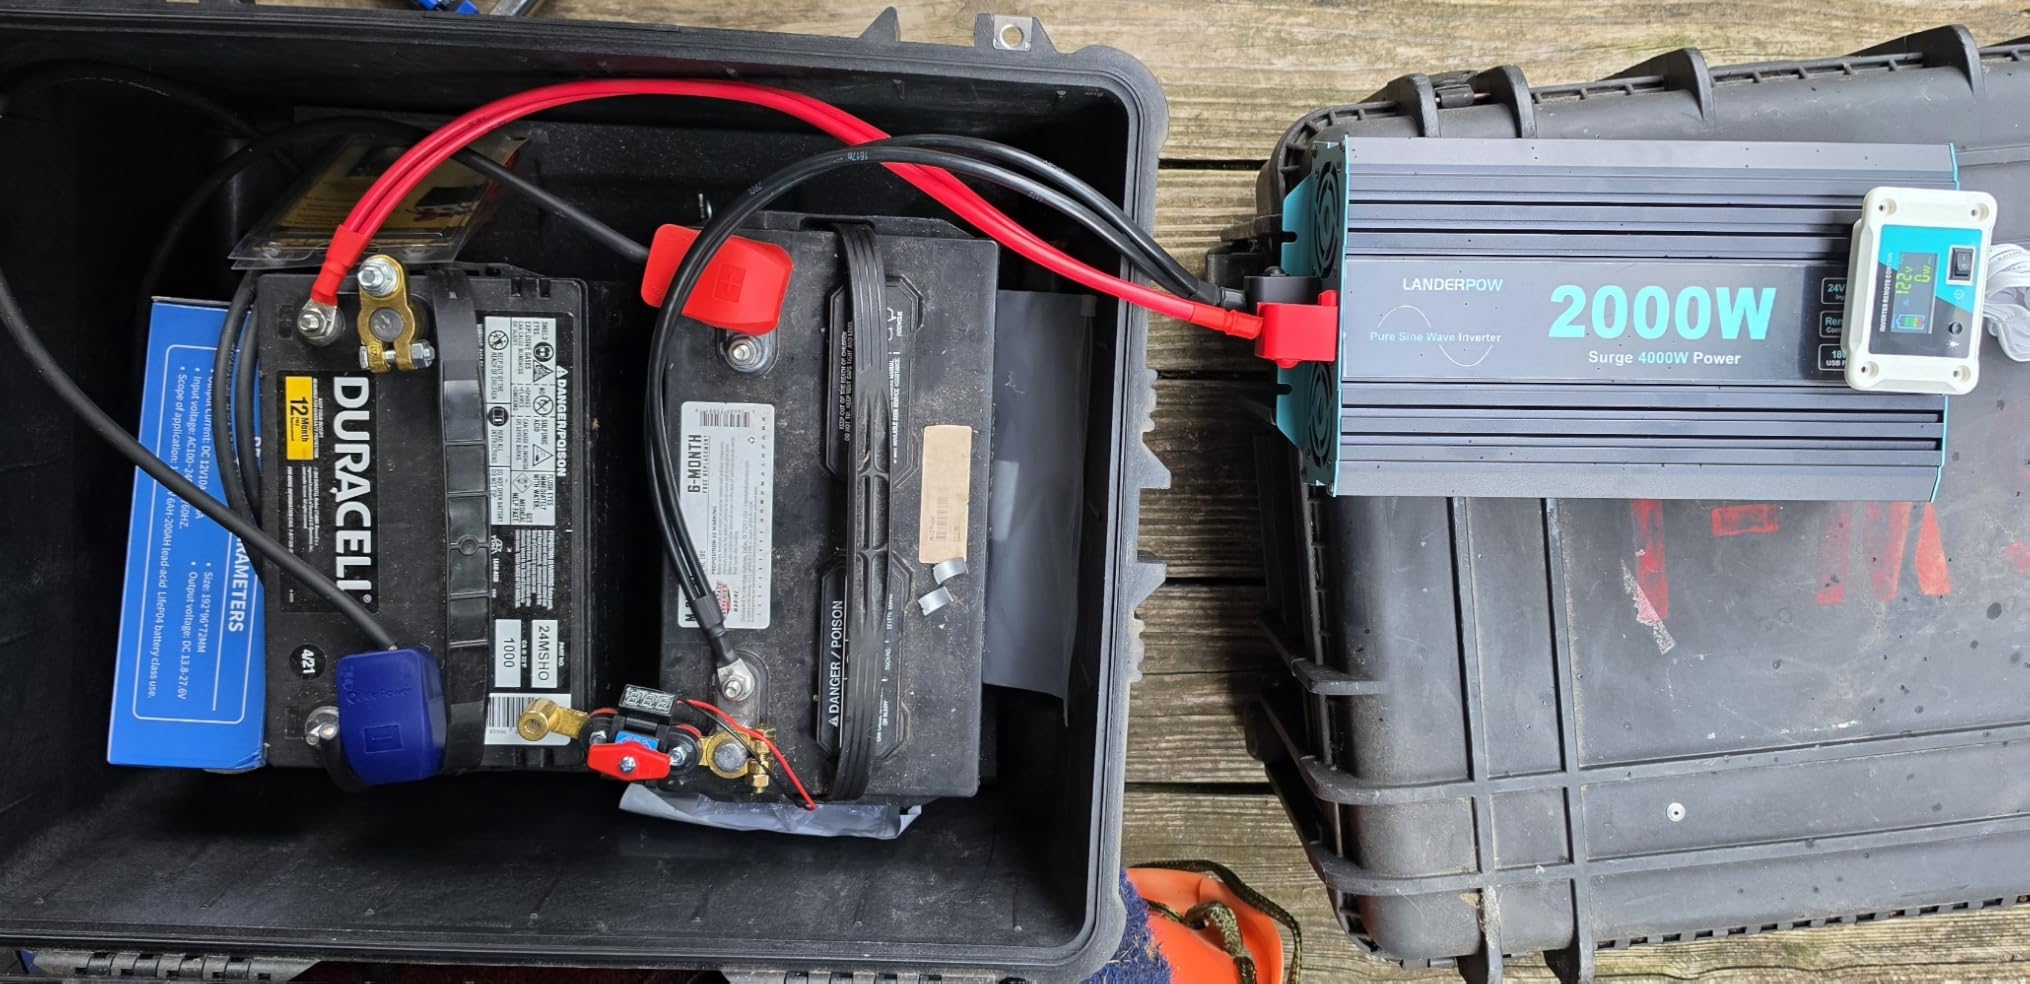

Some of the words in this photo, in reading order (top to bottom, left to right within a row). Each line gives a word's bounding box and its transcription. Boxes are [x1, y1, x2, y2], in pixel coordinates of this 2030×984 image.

[1402, 277, 1503, 292] LANDERPOW
[1882, 279, 1890, 302] REMOTE
[1548, 284, 1777, 340] 2000W
[1880, 303, 1888, 332] INVERTER
[1370, 331, 1396, 342] Pure
[1399, 331, 1423, 342] Sine
[1425, 332, 1456, 342] Wave
[1458, 332, 1502, 343] Inverter
[1588, 350, 1633, 367] Surge
[1638, 351, 1689, 363] 4000W
[1693, 352, 1742, 365] Power
[174, 374, 188, 400] Scope
[190, 376, 202, 400] Input
[176, 402, 186, 412] of
[186, 401, 200, 434] voltage:
[290, 396, 309, 416] 12
[301, 417, 310, 442] Month
[170, 412, 183, 464] application:
[557, 379, 567, 477] DANGER/POISON
[200, 446, 211, 458] DC
[687, 434, 702, 492] 6-MONTH
[162, 498, 176, 546] 6AH-200AH
[159, 548, 171, 587] lead-acid
[202, 572, 214, 592] Size:
[186, 572, 198, 603] Output
[228, 538, 250, 632] RAMETERS
[181, 604, 195, 638] voltage:
[831, 600, 843, 648] POISON
[150, 625, 164, 656] battery
[182, 641, 192, 654] DC
[503, 638, 515, 668] 1000
[538, 625, 550, 681] 24MSHO
[831, 650, 841, 660] /
[150, 658, 160, 680] class
[302, 649, 316, 674] 4/21
[148, 681, 156, 698] use.
[178, 656, 190, 700] 13.8-27.6V
[828, 662, 841, 714] DANGER
